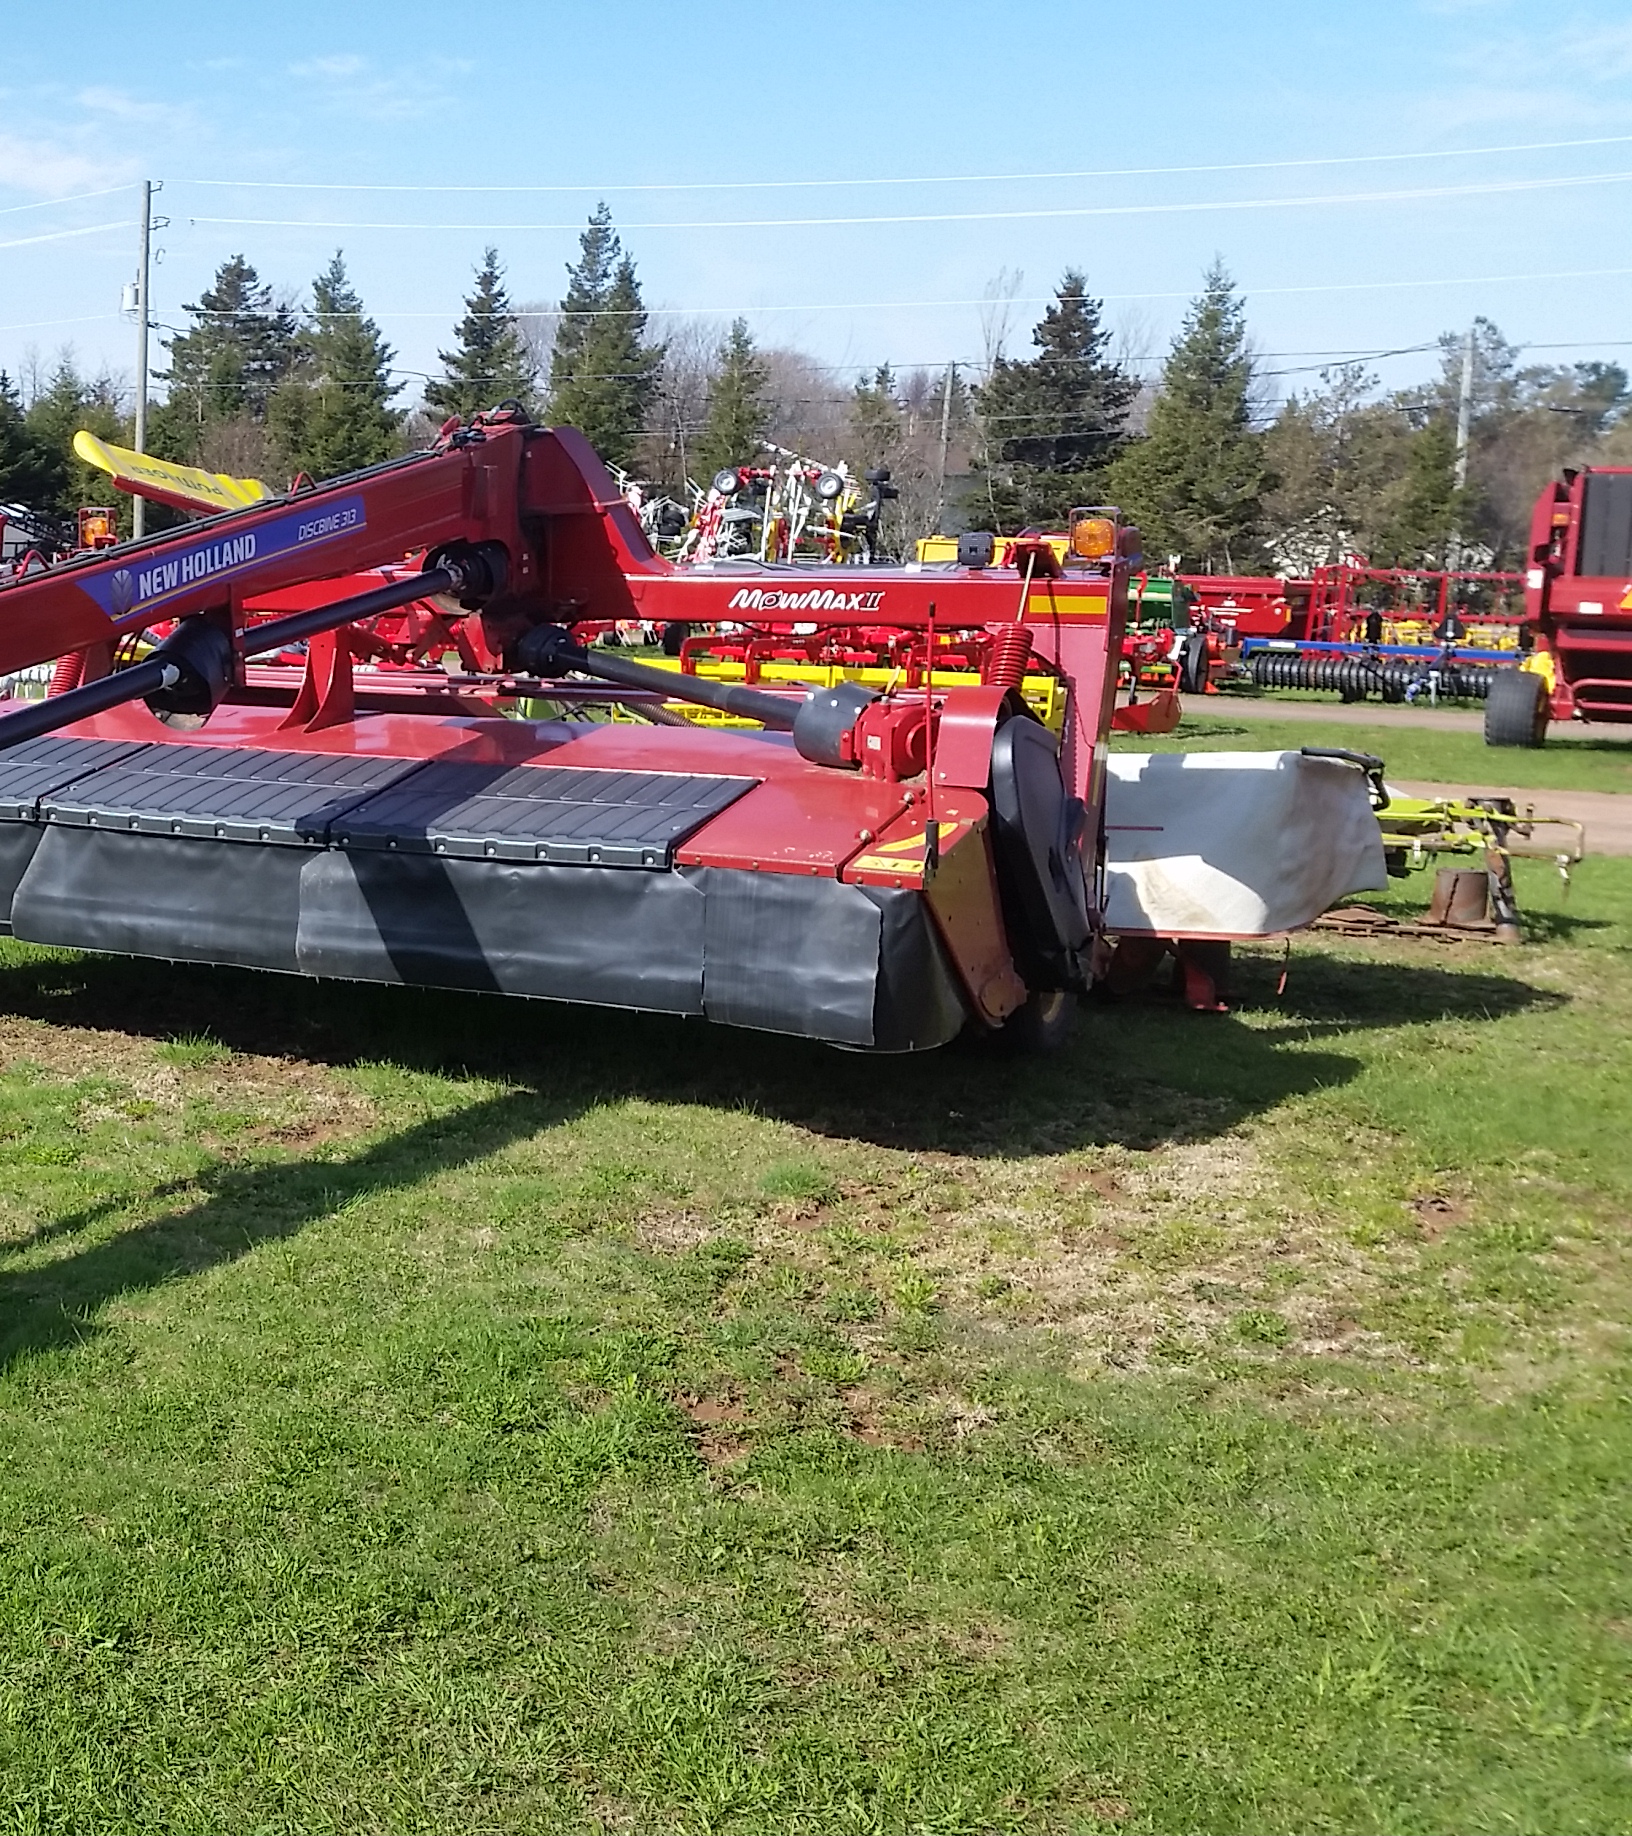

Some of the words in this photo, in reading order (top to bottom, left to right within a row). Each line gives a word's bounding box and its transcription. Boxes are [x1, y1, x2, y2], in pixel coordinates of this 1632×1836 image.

[298, 513, 341, 541] DISCBINE
[341, 508, 358, 528] 313
[139, 561, 180, 600] NEW
[181, 533, 257, 584] HOLLAND
